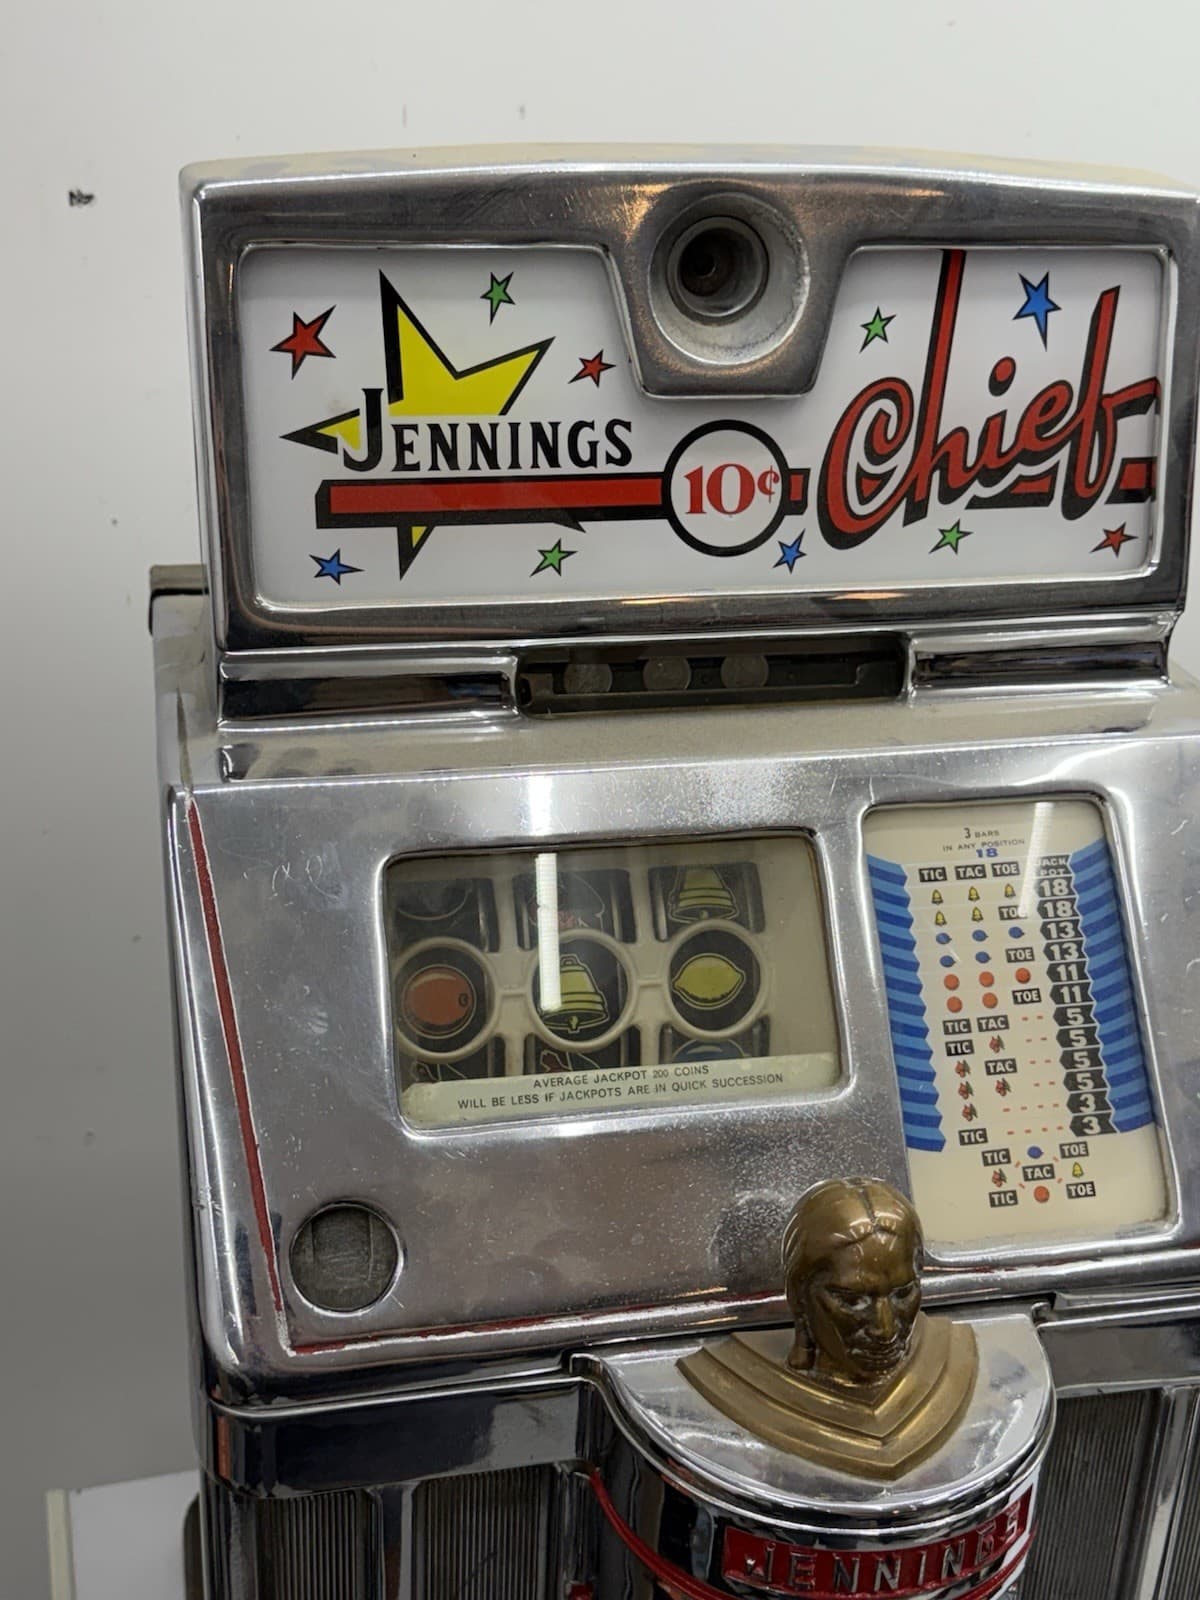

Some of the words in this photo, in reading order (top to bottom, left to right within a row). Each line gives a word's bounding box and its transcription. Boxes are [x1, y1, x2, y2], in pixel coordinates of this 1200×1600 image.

[817, 250, 1161, 550] Chief
[343, 388, 633, 472] JENNINGS
[964, 827, 971, 839] 3
[975, 830, 1000, 839] BARS
[957, 843, 976, 851] ANY
[981, 839, 1025, 848] POSITION
[976, 848, 998, 858] 18
[920, 867, 946, 881] TIC
[956, 865, 985, 879] TAC
[992, 862, 1020, 876] TOE
[1040, 878, 1069, 897] 18
[1001, 905, 1027, 919] TO
[1043, 900, 1073, 918] 18
[1047, 921, 1076, 940] 13
[1007, 948, 1034, 962] TOE
[1050, 942, 1080, 961] 13
[1056, 964, 1080, 982] 11
[1013, 989, 1040, 1004] TOE
[1060, 985, 1083, 1003] 11
[945, 1020, 971, 1033] TIC
[979, 1017, 1007, 1031] TAC
[1066, 1007, 1083, 1025] 5
[947, 1041, 972, 1054] TIC
[1069, 1029, 1086, 1047] 5
[986, 1060, 1015, 1074] TAC
[1073, 1051, 1091, 1069] 5
[533, 1074, 588, 1089] AVERAGE
[593, 1069, 647, 1083] JACKPOT
[653, 1069, 669, 1080] 200
[674, 1064, 709, 1077] COINS
[1077, 1072, 1095, 1090] 5
[458, 1097, 487, 1110] WILL
[492, 1096, 506, 1107] BE
[511, 1093, 539, 1106] LESS
[545, 1091, 555, 1102] IF
[560, 1087, 622, 1102] JACKPOTS
[627, 1084, 650, 1096] ARE
[655, 1082, 667, 1093] IN
[671, 1079, 708, 1092] QUICK
[712, 1073, 783, 1088] SUCCESSION
[1080, 1094, 1096, 1112] 3
[961, 1130, 986, 1143] TIC
[1082, 1116, 1100, 1134] 3
[984, 1150, 1010, 1164] TIC
[1061, 1143, 1087, 1157] TOE
[1024, 1165, 1053, 1180] TAC
[991, 1192, 1017, 1206] TIC
[1068, 1183, 1094, 1197] TOE
[746, 1500, 1020, 1591] JENNINGS
